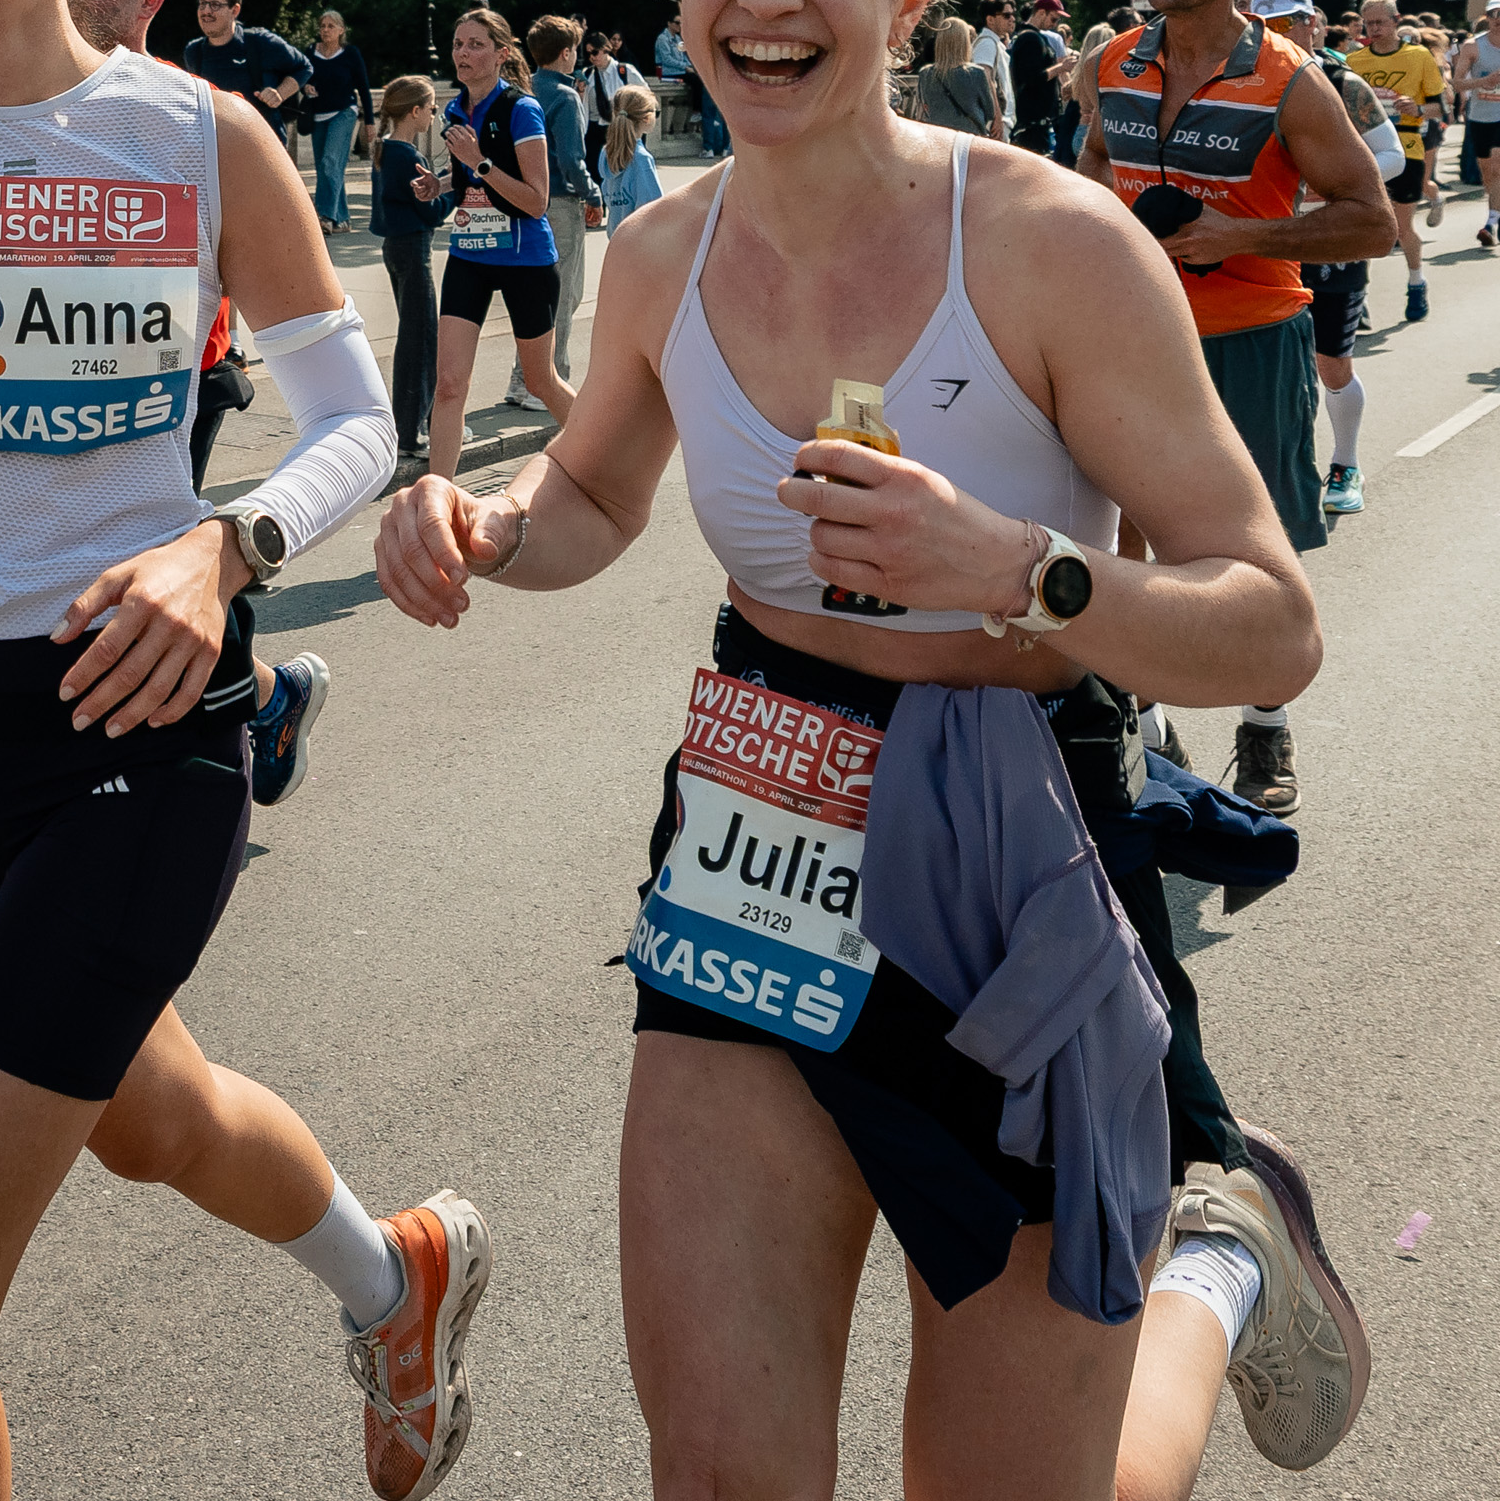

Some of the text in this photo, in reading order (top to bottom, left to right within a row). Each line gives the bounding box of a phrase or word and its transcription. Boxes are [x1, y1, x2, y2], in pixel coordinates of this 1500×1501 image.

[1103, 118, 1240, 152] PALAZZO DEL SOL
[53, 254, 66, 262] 19.
[68, 254, 93, 262] APRIL
[94, 254, 116, 262] 2026
[458, 238, 485, 249] ERSTE
[14, 287, 172, 345] Anna
[71, 359, 118, 376] 27462
[694, 676, 825, 750] WIENER
[684, 711, 815, 786] TISCHE
[684, 757, 748, 788] HALBMARATHON
[752, 784, 767, 796] 19.
[768, 790, 796, 807] APRIL
[797, 801, 822, 815] 2026
[697, 811, 860, 919] Julia
[738, 902, 792, 934] 23129
[629, 913, 791, 1017] RKASSE
